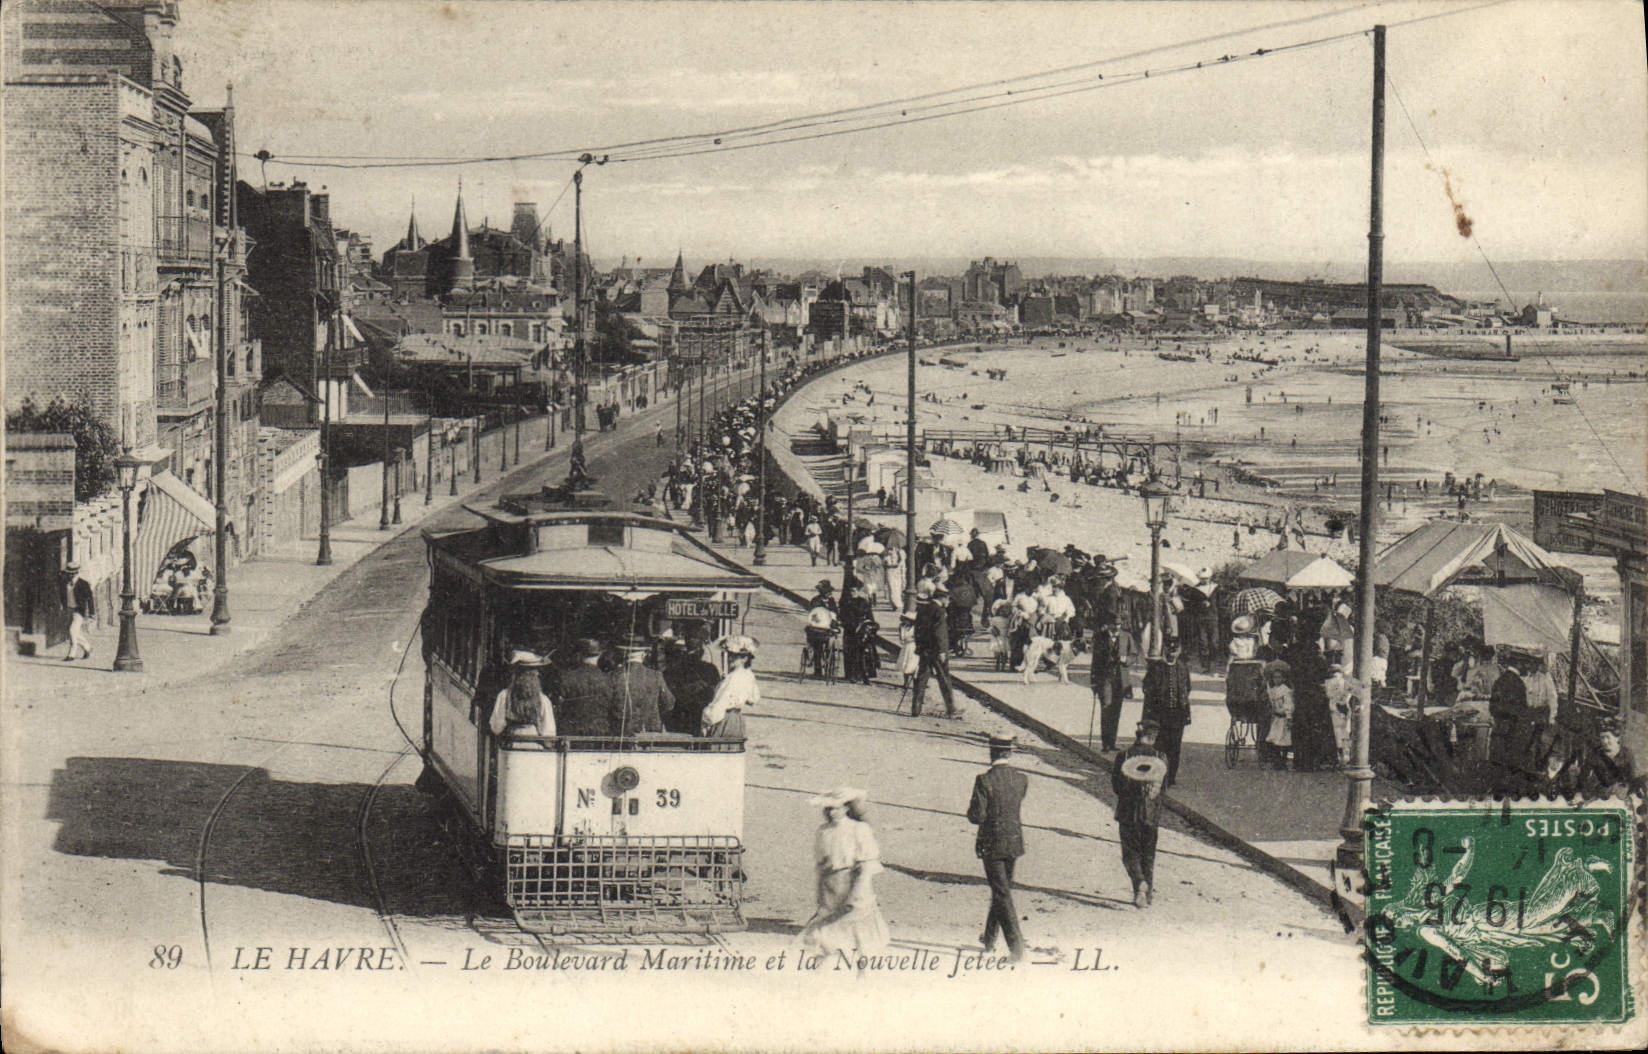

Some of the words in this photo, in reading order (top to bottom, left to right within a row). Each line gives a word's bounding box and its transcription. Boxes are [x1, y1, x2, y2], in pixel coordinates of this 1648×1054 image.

[667, 602, 700, 617] HOTEL
[708, 602, 737, 617] VILLE
[655, 788, 681, 808] 39
[1525, 818, 1610, 838] POSTES
